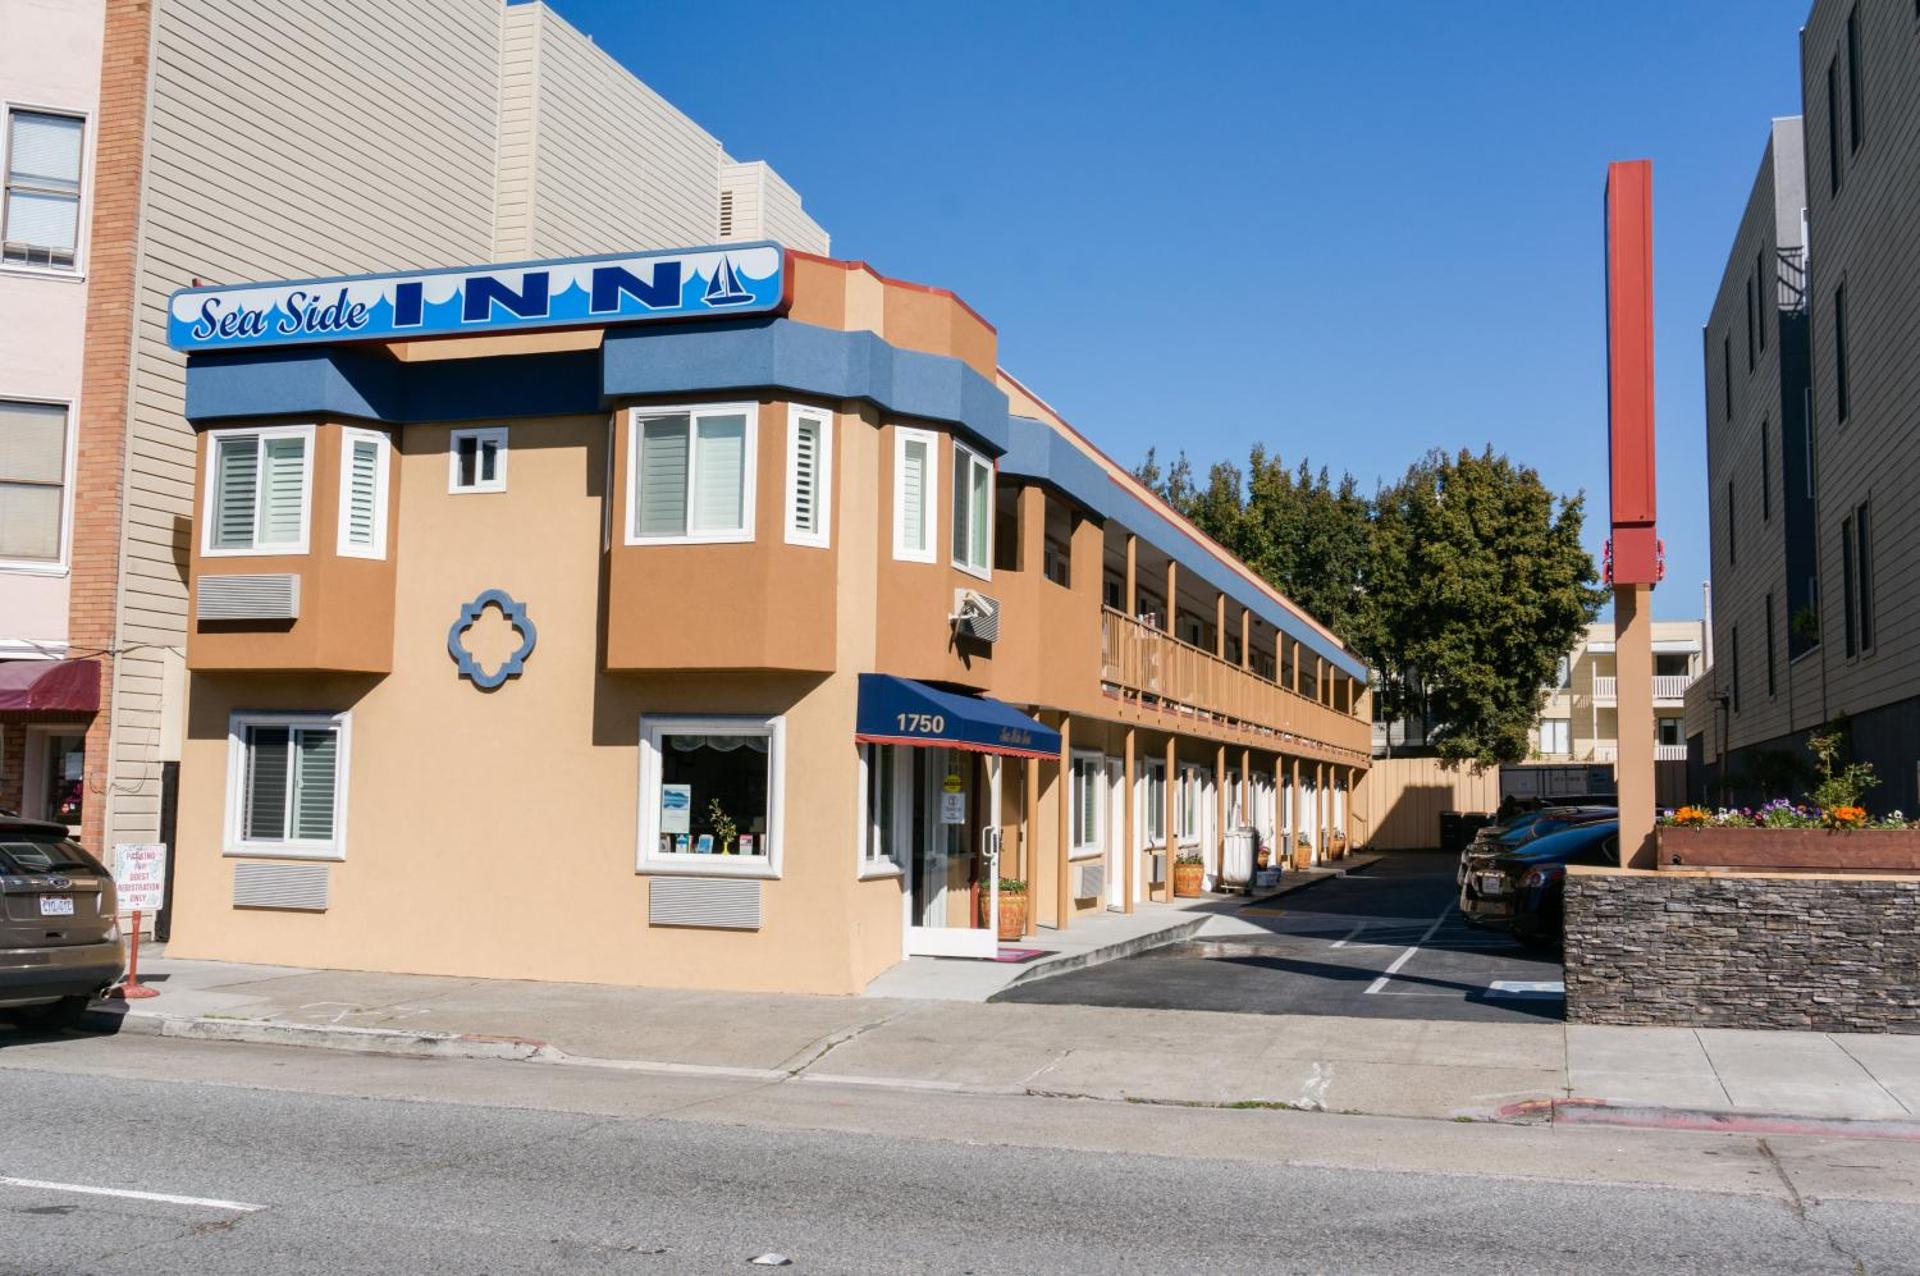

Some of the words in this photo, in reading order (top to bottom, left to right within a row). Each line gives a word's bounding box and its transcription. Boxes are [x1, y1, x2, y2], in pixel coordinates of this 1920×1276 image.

[193, 296, 266, 338] Sea
[278, 288, 368, 332] Side
[394, 261, 681, 326] INN
[896, 713, 945, 735] 1750
